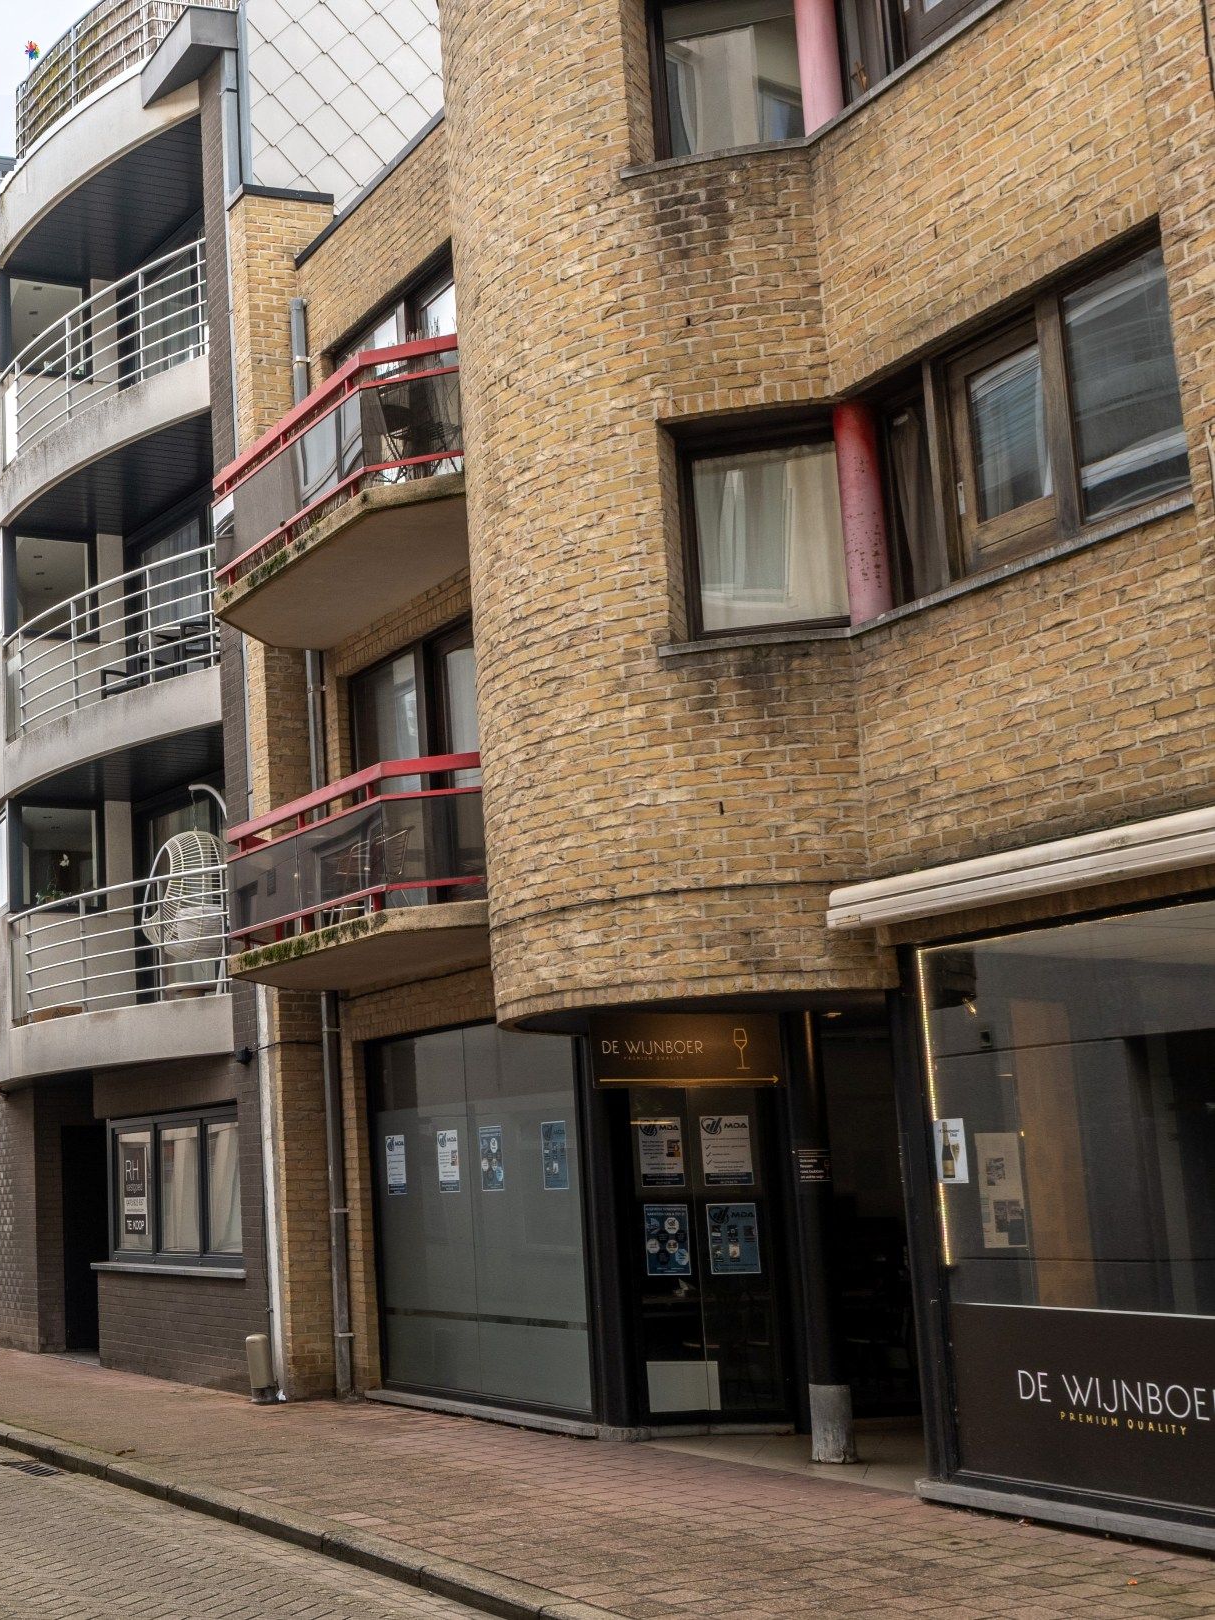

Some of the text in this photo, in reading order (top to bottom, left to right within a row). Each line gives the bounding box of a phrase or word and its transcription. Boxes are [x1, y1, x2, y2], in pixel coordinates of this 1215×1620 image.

[601, 1040, 703, 1055] DE WIJNBOER
[125, 1159, 139, 1181] RH
[126, 1220, 132, 1230] TE
[1018, 1369, 1215, 1421] DE WIJNBOE
[1060, 1411, 1187, 1436] PREMIUM QUALITY
